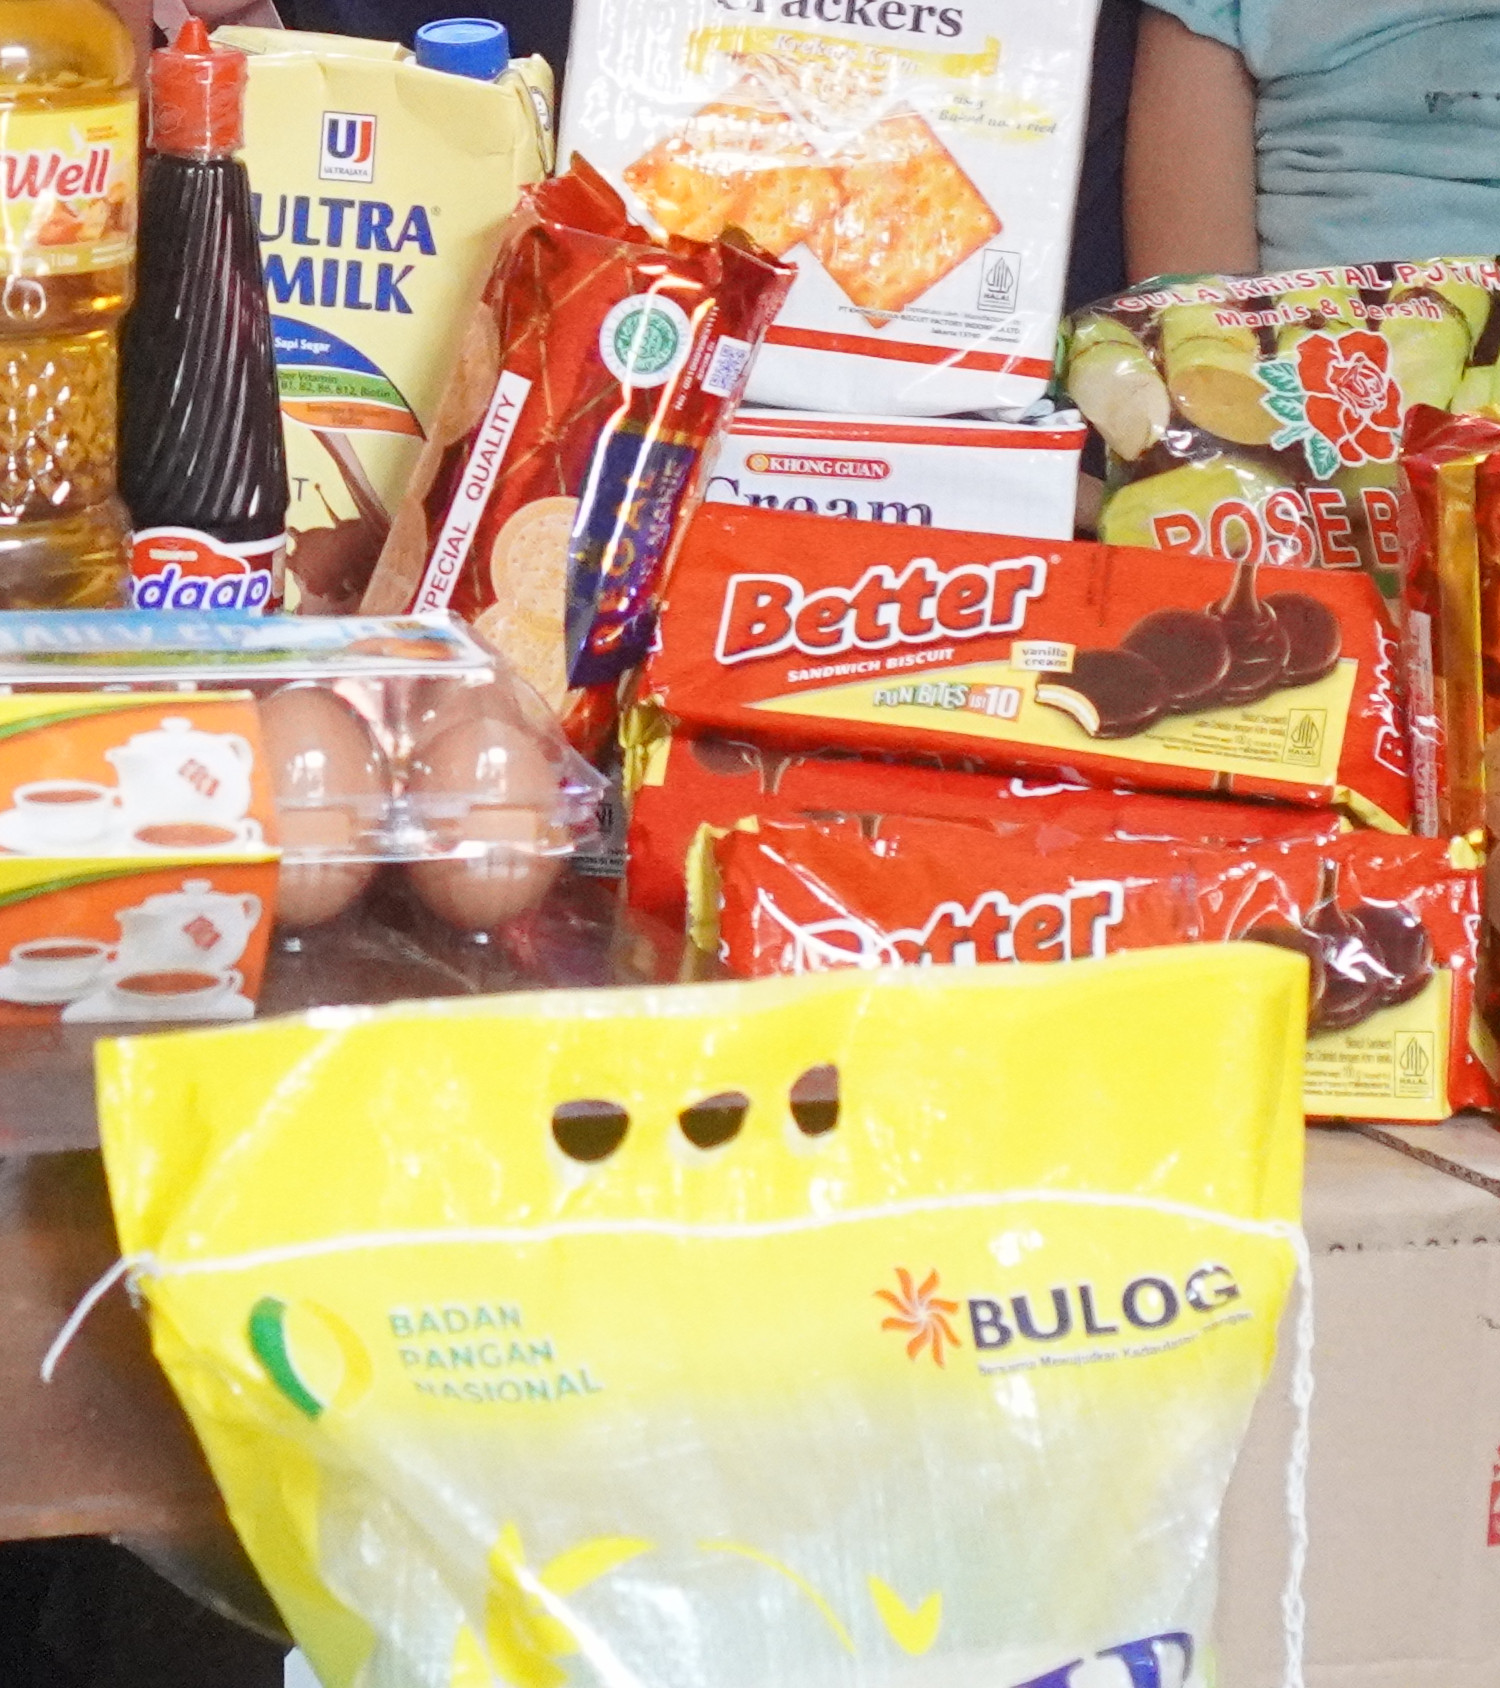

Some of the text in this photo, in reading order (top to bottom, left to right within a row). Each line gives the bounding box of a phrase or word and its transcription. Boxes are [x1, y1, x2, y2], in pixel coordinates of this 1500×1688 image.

[327, 117, 373, 164] UJ
[250, 192, 438, 255] ULTRA
[262, 253, 416, 315] MILK
[1116, 287, 1221, 312] GULA
[1226, 264, 1393, 300] KRISTAL
[1215, 297, 1443, 328] Manis & Bersih
[274, 337, 331, 354] Sapi Segar
[466, 393, 516, 501] QUALITY
[769, 457, 885, 479] KHONG GUAN
[1153, 488, 1361, 568] ROSE
[716, 555, 1047, 665] Better
[787, 648, 954, 683] SANDWICH BISCUIT
[388, 1305, 523, 1338] BADAN
[967, 1262, 1241, 1351] BULOG
[399, 1338, 556, 1368] PANGAN
[414, 1366, 605, 1404] NASIONAL
